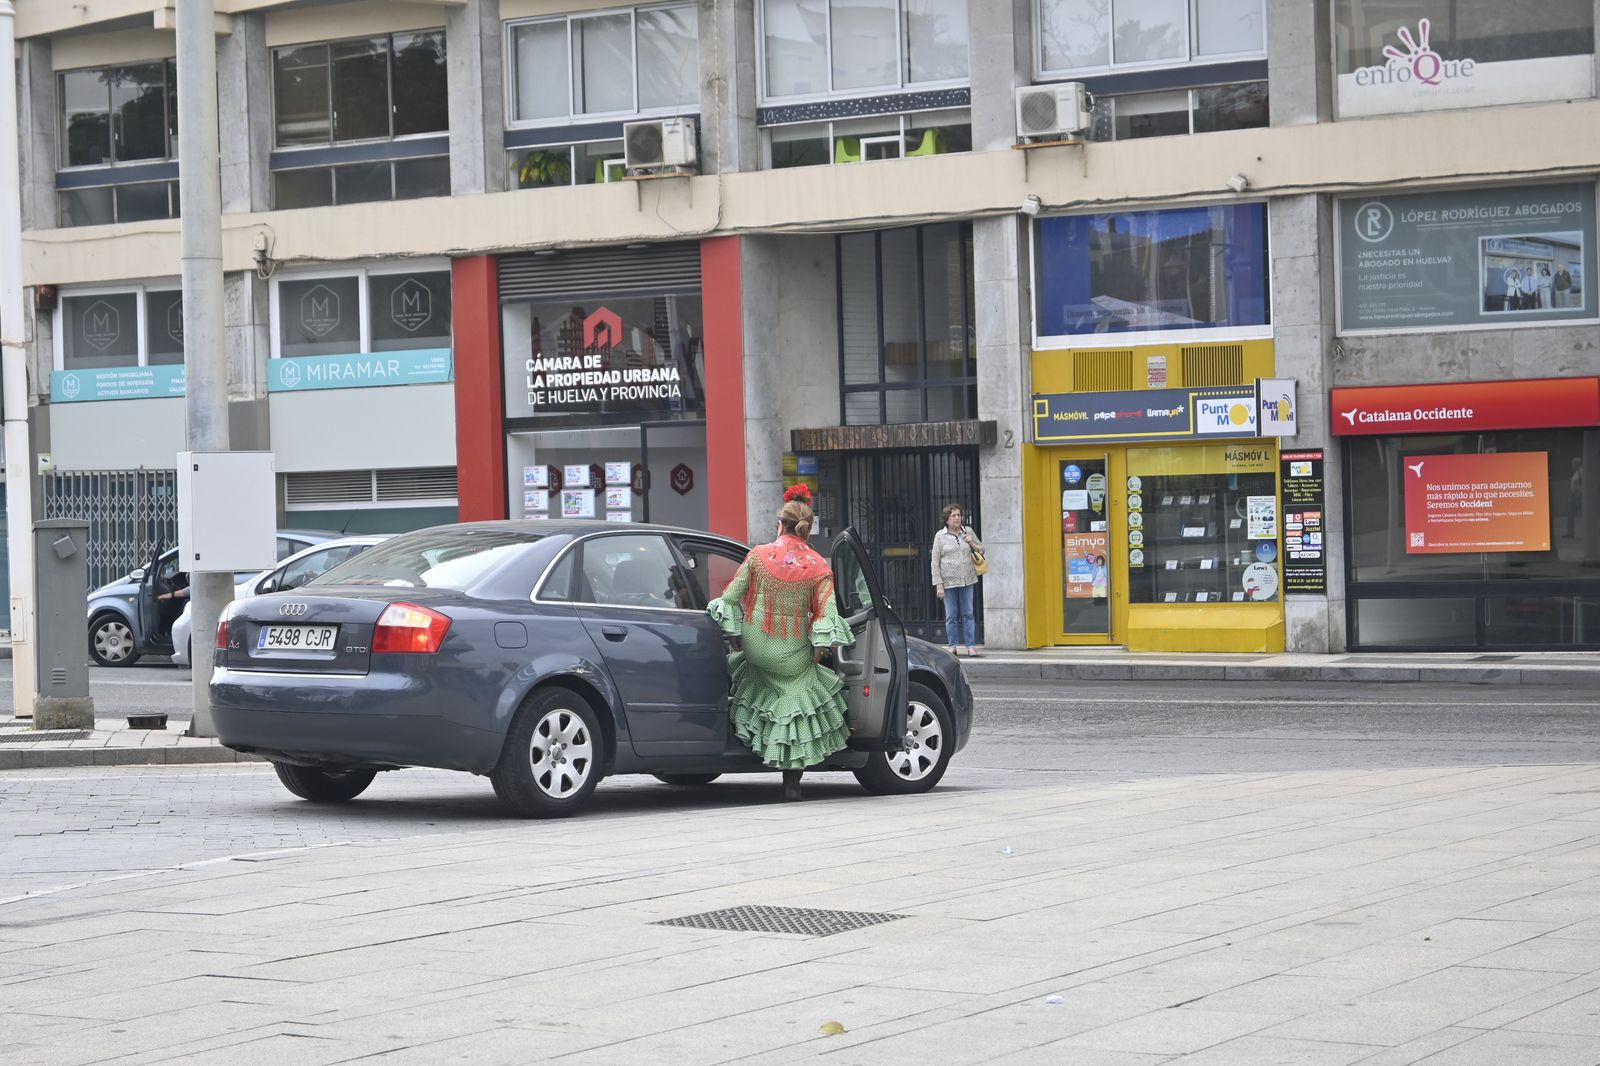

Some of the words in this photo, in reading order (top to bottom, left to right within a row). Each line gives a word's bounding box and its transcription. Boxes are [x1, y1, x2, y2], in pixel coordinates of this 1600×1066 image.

[1355, 54, 1475, 86] enfoQue
[1401, 209, 1438, 223] LÓPEZ
[1442, 205, 1511, 220] RODRÍGUEZ
[1514, 202, 1582, 216] ABOGADOS
[1358, 259, 1400, 268] ABOGADO
[1416, 256, 1452, 265] HUELVA?
[1388, 280, 1424, 290] prioridad
[306, 360, 400, 382] MIRAMAR
[526, 353, 582, 372] CÁMARA
[583, 354, 602, 369] DE
[527, 374, 544, 389] LA
[546, 370, 621, 388] PROPIEDAD
[623, 368, 680, 383] URBANA
[528, 391, 545, 405] DE
[548, 388, 598, 404] HUELVA
[599, 387, 609, 400] Y
[611, 384, 682, 400] PROVINCIA
[1358, 410, 1412, 423] Catalana
[1414, 408, 1474, 420] Occidente
[1004, 429, 1014, 448] 2
[1426, 483, 1440, 491] Nos
[1442, 482, 1470, 491] unimos
[1471, 482, 1488, 492] para
[1490, 481, 1532, 491] adaptarnos
[1426, 492, 1442, 500] más
[1444, 491, 1468, 501] rápido
[1484, 492, 1498, 500] que
[1499, 490, 1535, 498] necesites.
[1426, 501, 1459, 509] Seremos
[1460, 500, 1493, 508] Occident
[1067, 536, 1105, 549] simyo
[268, 628, 300, 646] 5498
[305, 629, 332, 646] CJR
